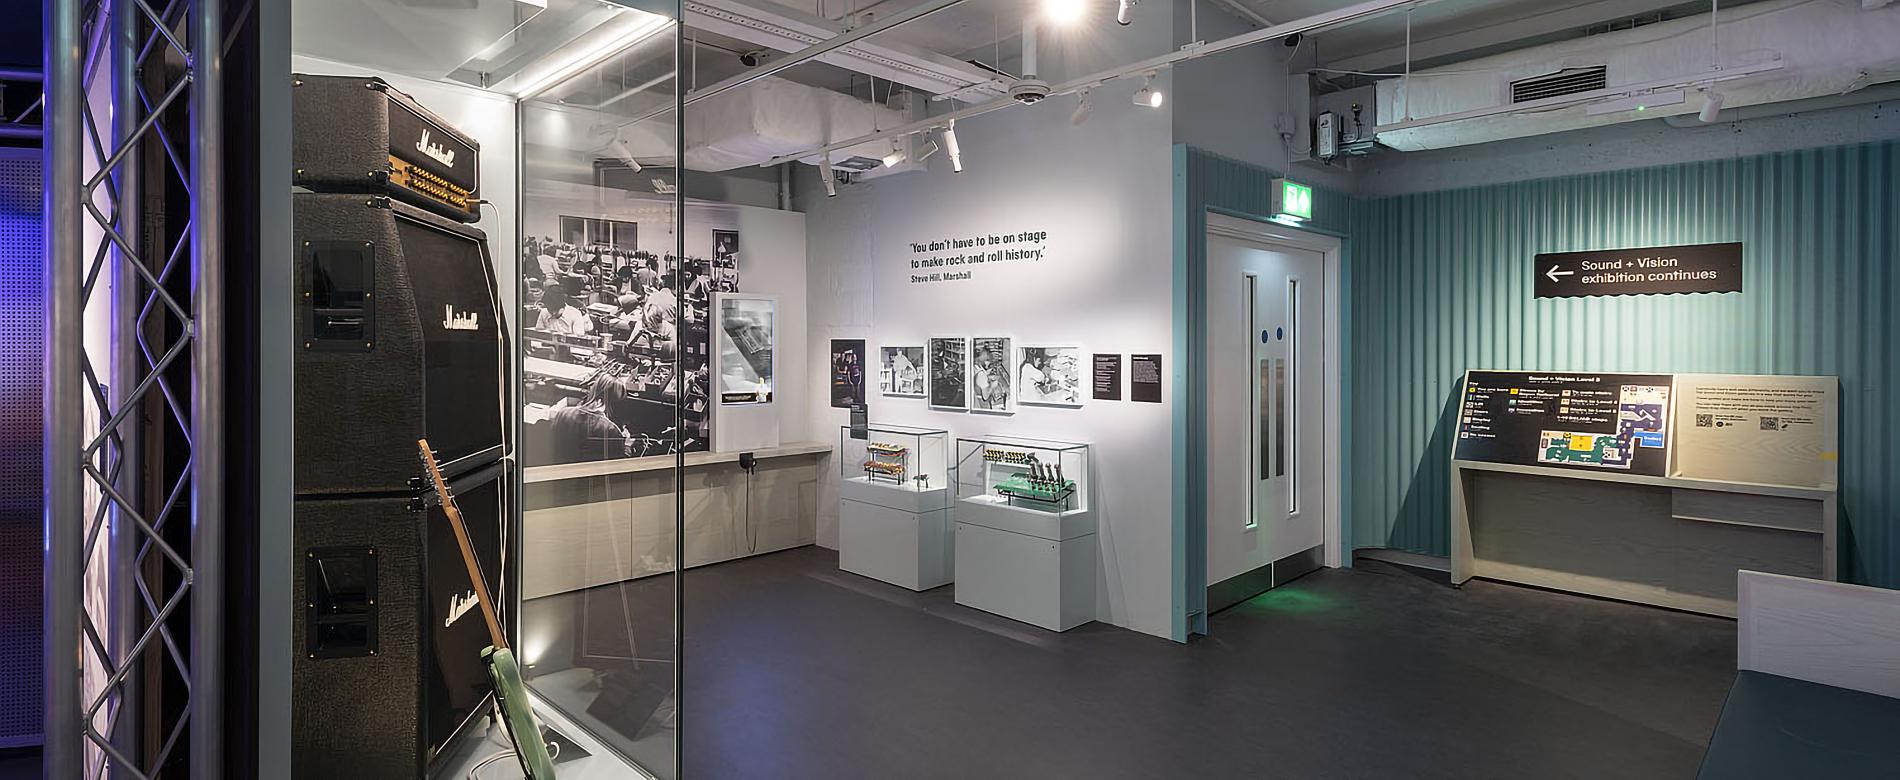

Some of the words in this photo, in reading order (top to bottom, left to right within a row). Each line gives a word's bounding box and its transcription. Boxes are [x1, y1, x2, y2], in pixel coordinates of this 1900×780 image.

[416, 129, 455, 168] Marshall
[952, 238, 974, 249] have
[976, 236, 986, 246] to
[988, 234, 1000, 245] be
[1002, 234, 1015, 244] on
[1018, 230, 1046, 244] stage
[911, 259, 920, 269] to
[921, 257, 944, 268] make
[946, 254, 966, 266] rock
[967, 252, 985, 264] and
[987, 250, 1003, 262] roll
[1582, 259, 1622, 271] Sound
[1636, 256, 1678, 268] Vision
[911, 274, 928, 284] Steve
[930, 273, 942, 283] Hill,
[943, 271, 972, 282] Marshall
[1582, 270, 1645, 284] exhibition
[1648, 269, 1717, 282] continues
[443, 304, 478, 330] Marshall
